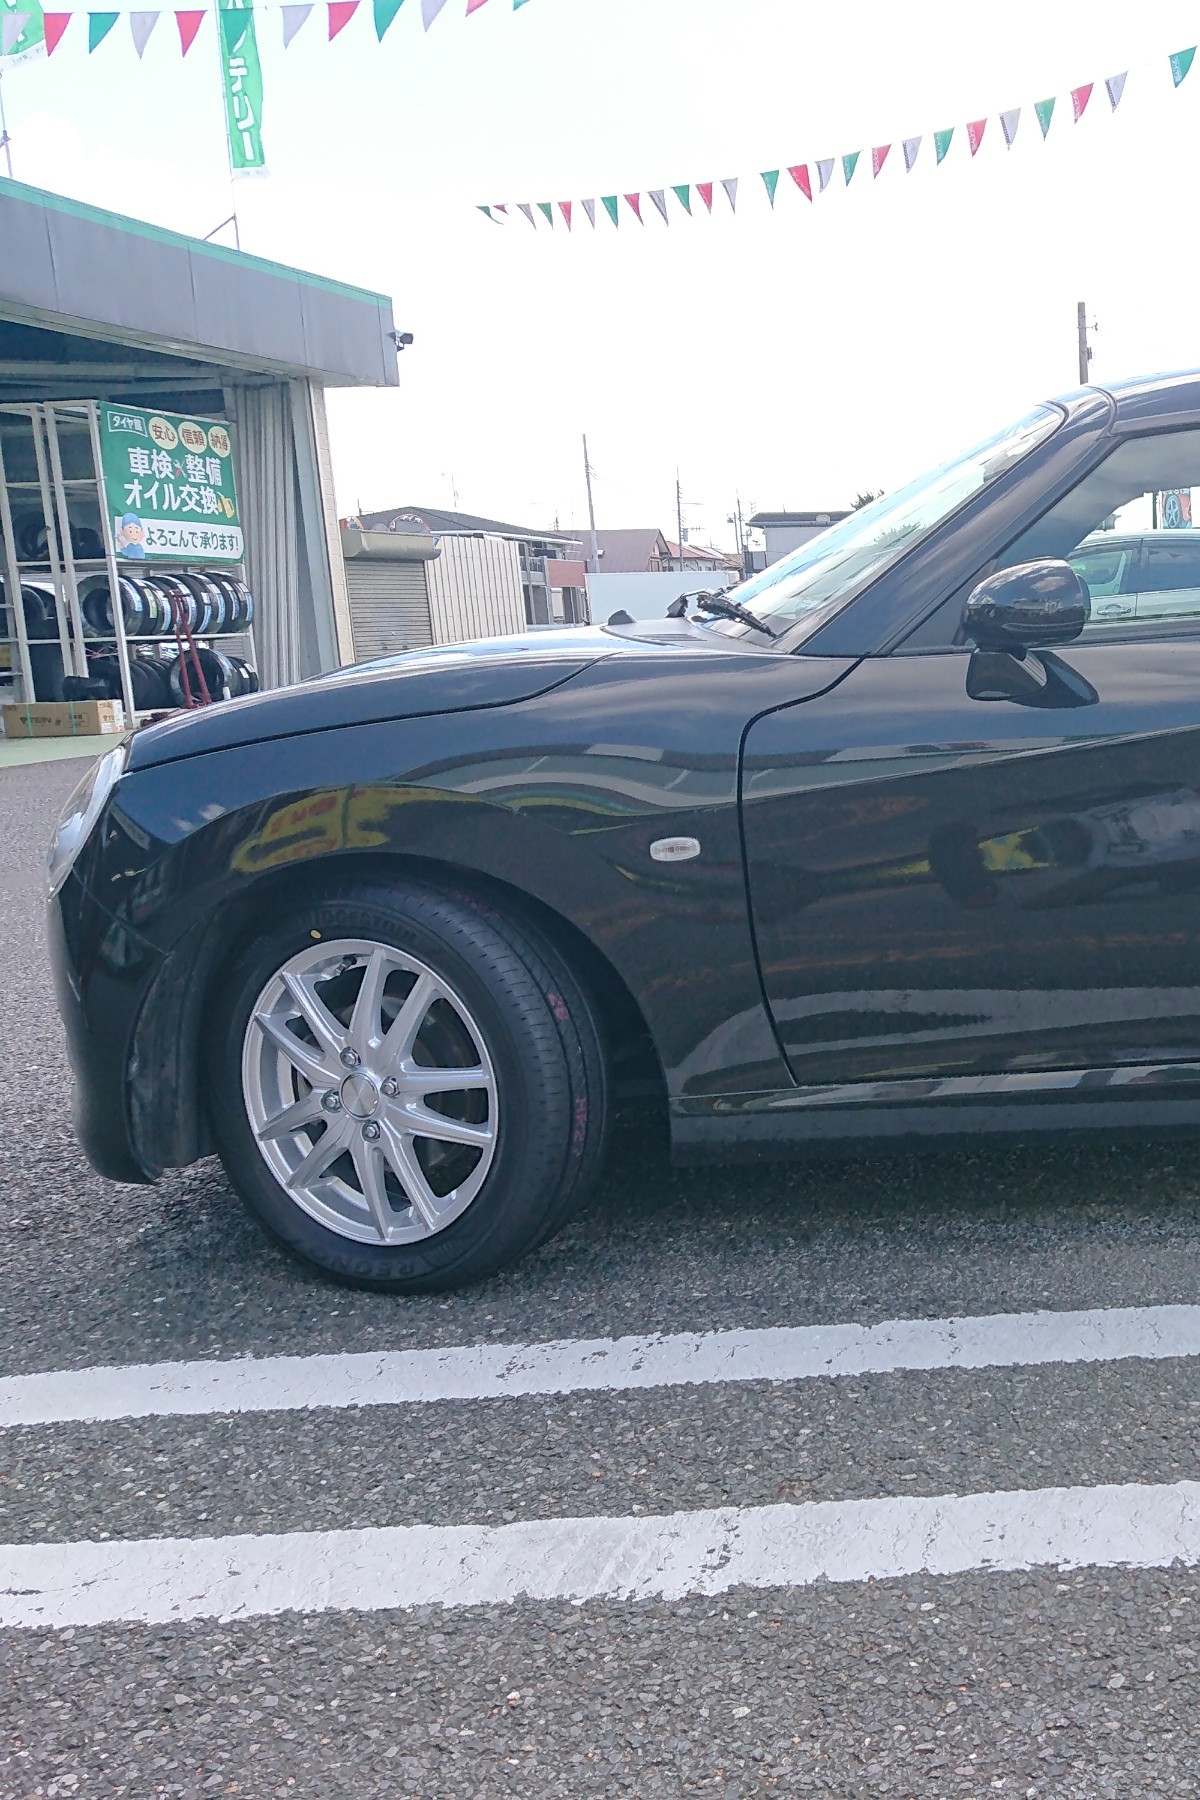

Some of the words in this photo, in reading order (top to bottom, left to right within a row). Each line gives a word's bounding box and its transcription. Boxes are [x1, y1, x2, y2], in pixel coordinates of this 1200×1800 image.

[151, 423, 176, 442] 安心
[181, 427, 206, 447] 信頼
[210, 432, 229, 451] 納得
[127, 446, 175, 480] 車検
[184, 453, 223, 487] 整備
[123, 478, 219, 516] オイル交換
[145, 526, 239, 551] よろこんで承ります!
